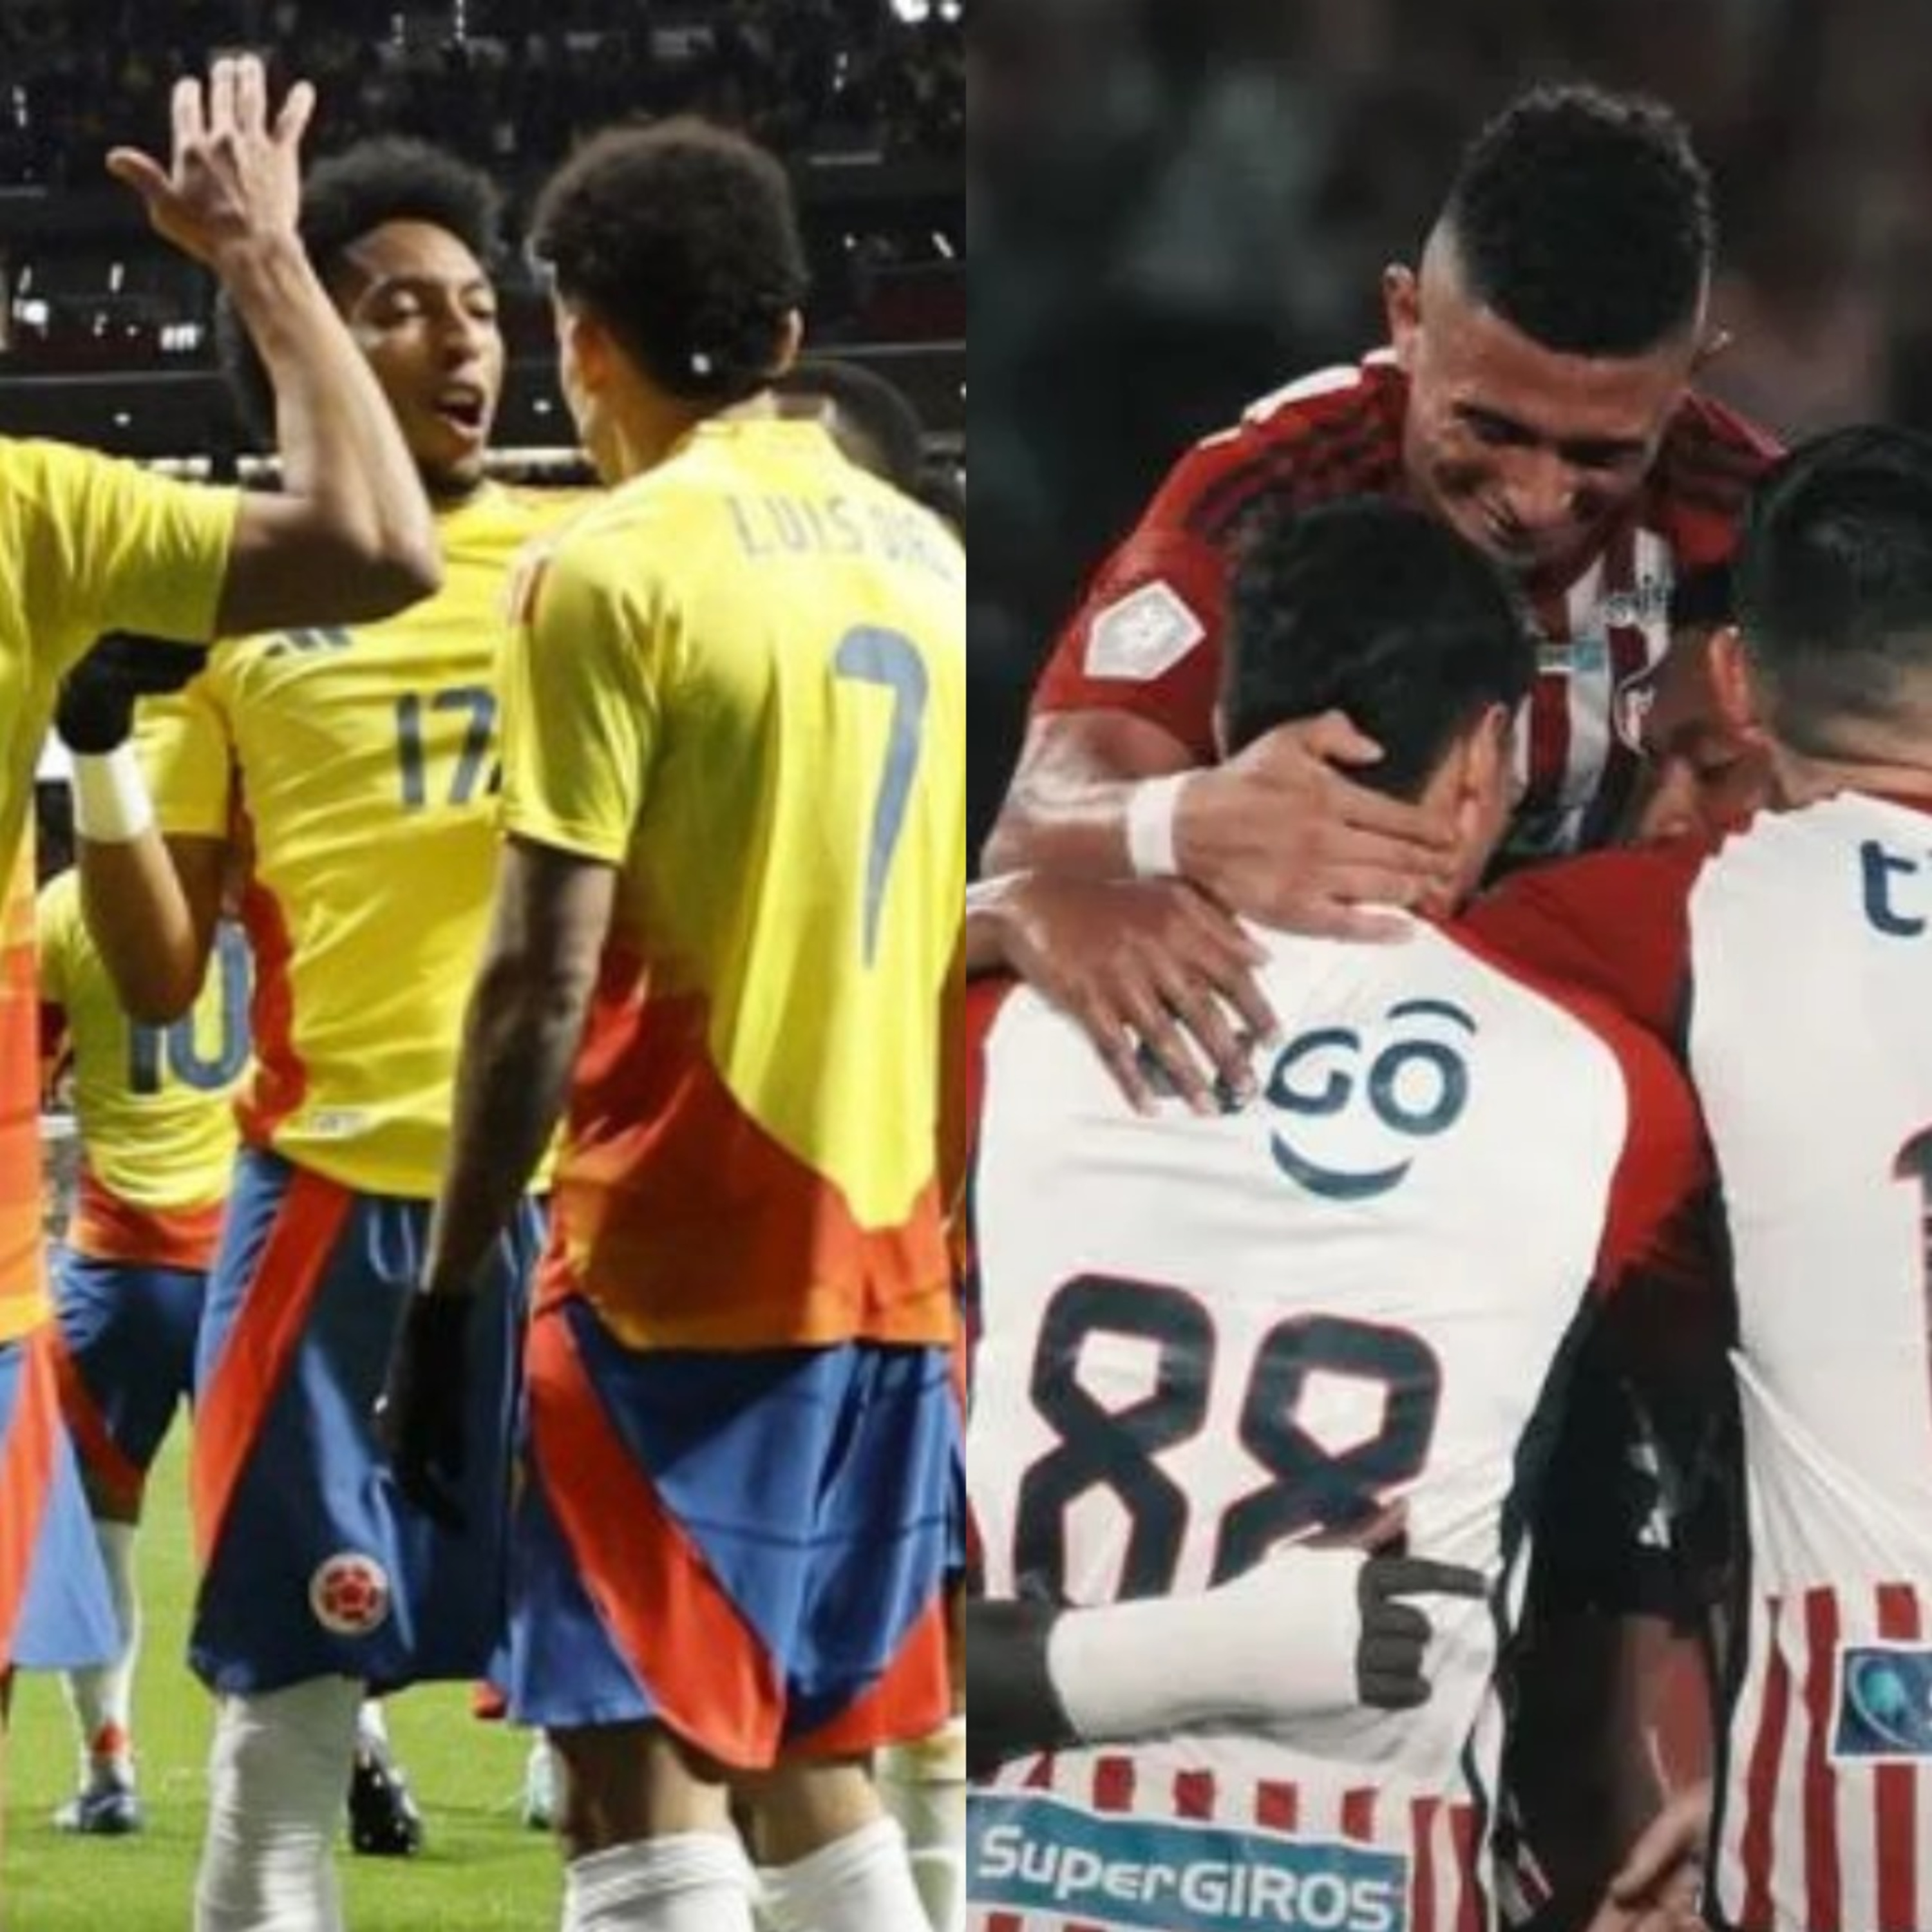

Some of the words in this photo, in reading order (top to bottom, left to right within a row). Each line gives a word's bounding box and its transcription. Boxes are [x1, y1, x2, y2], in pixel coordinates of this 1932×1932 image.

[725, 495, 864, 559] LUIS
[395, 684, 497, 808] 17
[835, 623, 929, 969] 7
[1012, 1273, 1441, 1606] 88
[977, 1824, 1395, 1932] SuperGIROS
